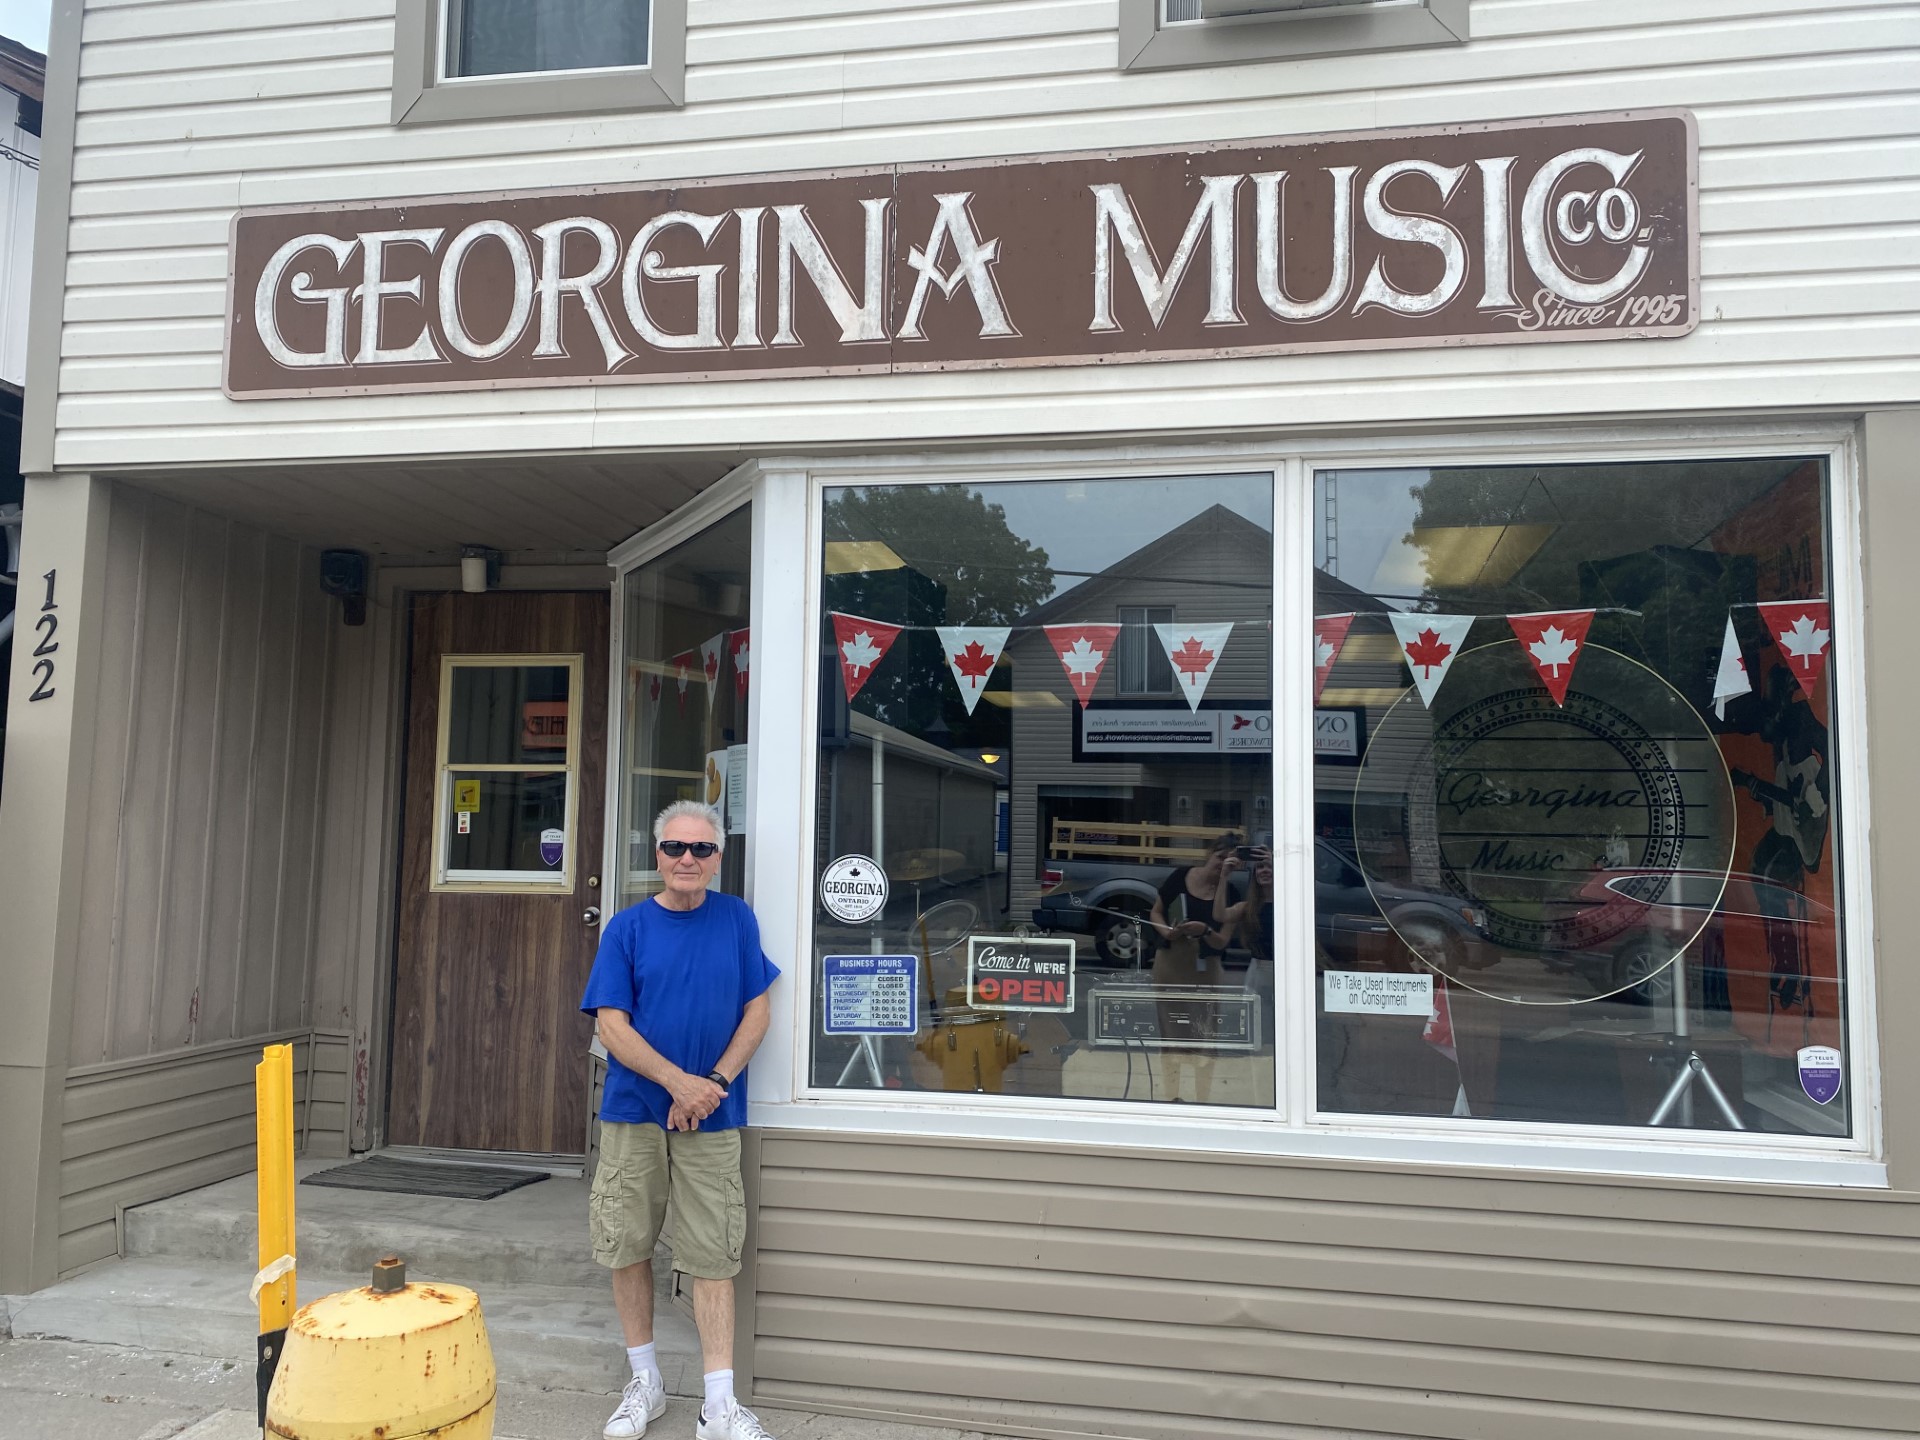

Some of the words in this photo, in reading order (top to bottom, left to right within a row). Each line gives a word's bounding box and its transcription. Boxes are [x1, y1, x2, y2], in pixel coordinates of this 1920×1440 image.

[254, 191, 1016, 373] GEORGINA
[1087, 147, 1651, 332] MUSIC
[1518, 287, 1615, 331] Since
[1615, 294, 1687, 327] 1995
[29, 568, 59, 702] 122
[1448, 772, 1641, 818] Georgina
[837, 859, 854, 869] SHOP
[857, 859, 877, 873] LOCAL
[1470, 840, 1564, 871] Music
[824, 880, 884, 896] GEORGINA
[829, 902, 856, 919] SUPPORT
[857, 905, 877, 918] LOCAL
[837, 897, 870, 905] ONTARIO
[839, 959, 875, 968] BUSINESS
[878, 959, 903, 968] HOURS
[977, 946, 1015, 969] Come
[1016, 953, 1031, 970] in
[1034, 962, 1067, 975] WE'RE
[978, 977, 1065, 1004] OPEN
[1329, 974, 1341, 990] We
[1344, 975, 1362, 990] Take
[1364, 976, 1383, 991] Used
[1386, 977, 1428, 993] Instruments
[1348, 992, 1359, 1005] on
[1361, 990, 1408, 1009] Consignment
